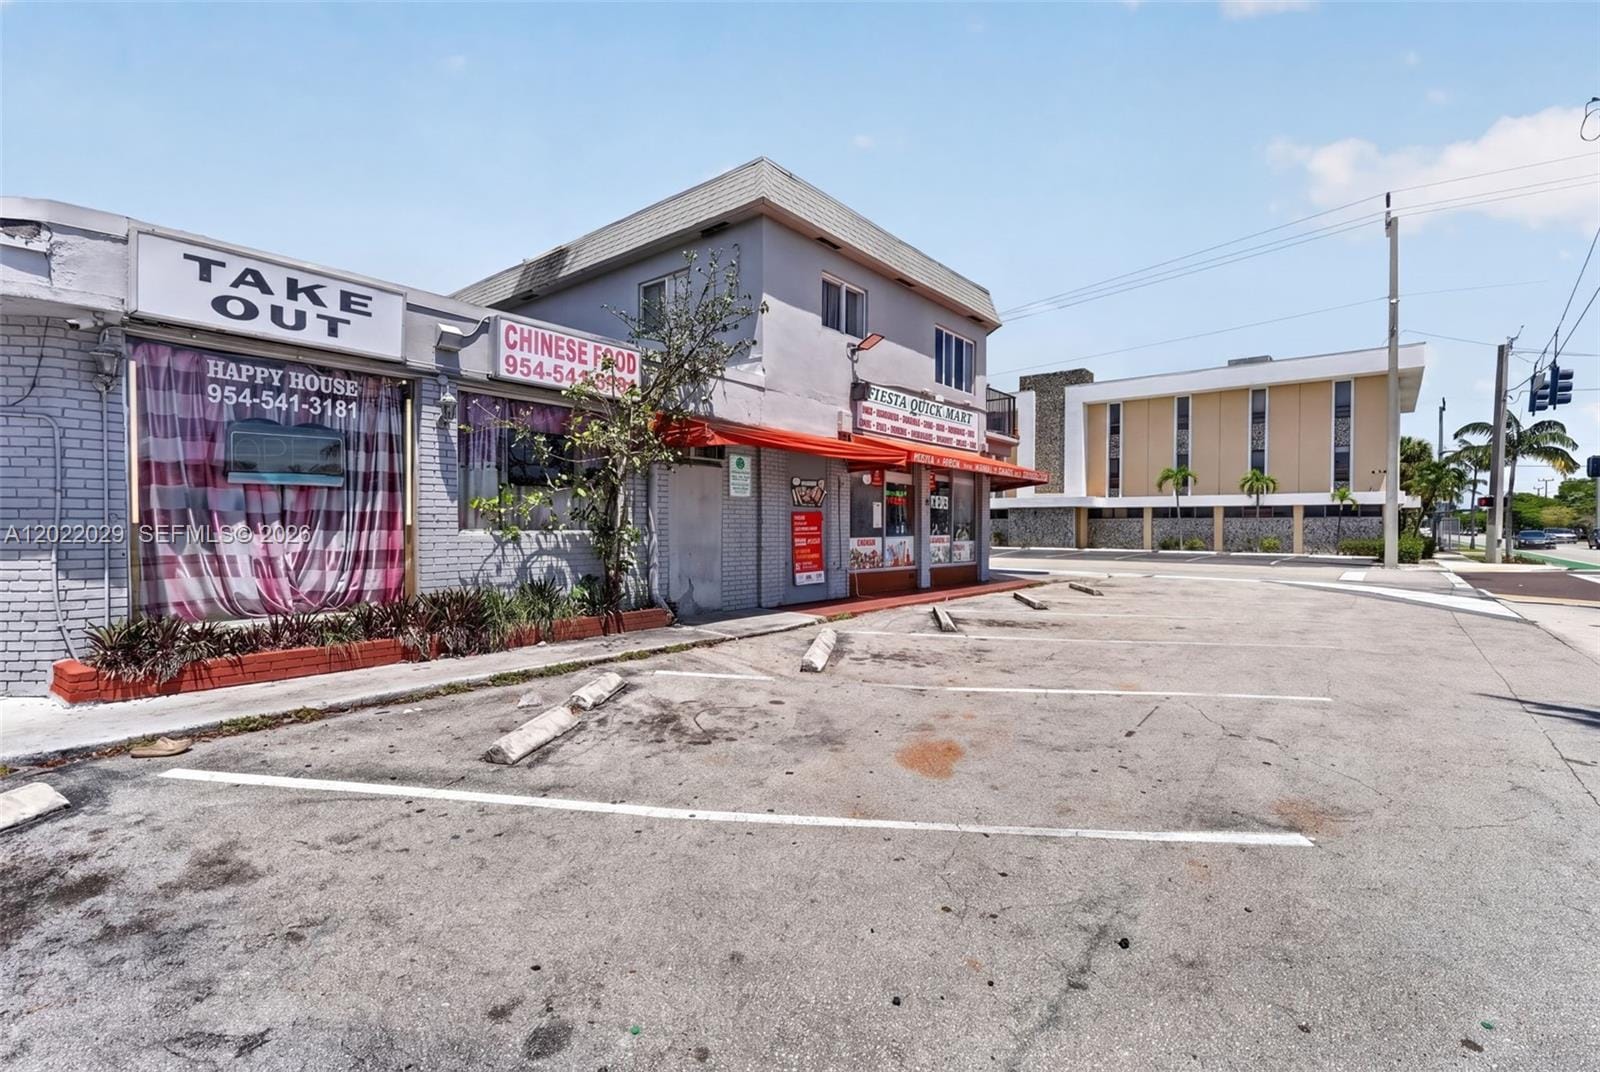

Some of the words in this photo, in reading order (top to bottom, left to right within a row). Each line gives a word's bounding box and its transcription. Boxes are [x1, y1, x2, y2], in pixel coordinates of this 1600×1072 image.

[183, 253, 373, 318] TAKE
[211, 295, 351, 338] OUT
[504, 324, 588, 366] CHINESE
[207, 359, 283, 387] HAPPY
[289, 371, 358, 397] HOUSE
[207, 383, 357, 419] 954-541-3181
[868, 387, 907, 409] FIESTA
[909, 398, 943, 418] QUICK
[945, 407, 973, 425] MART
